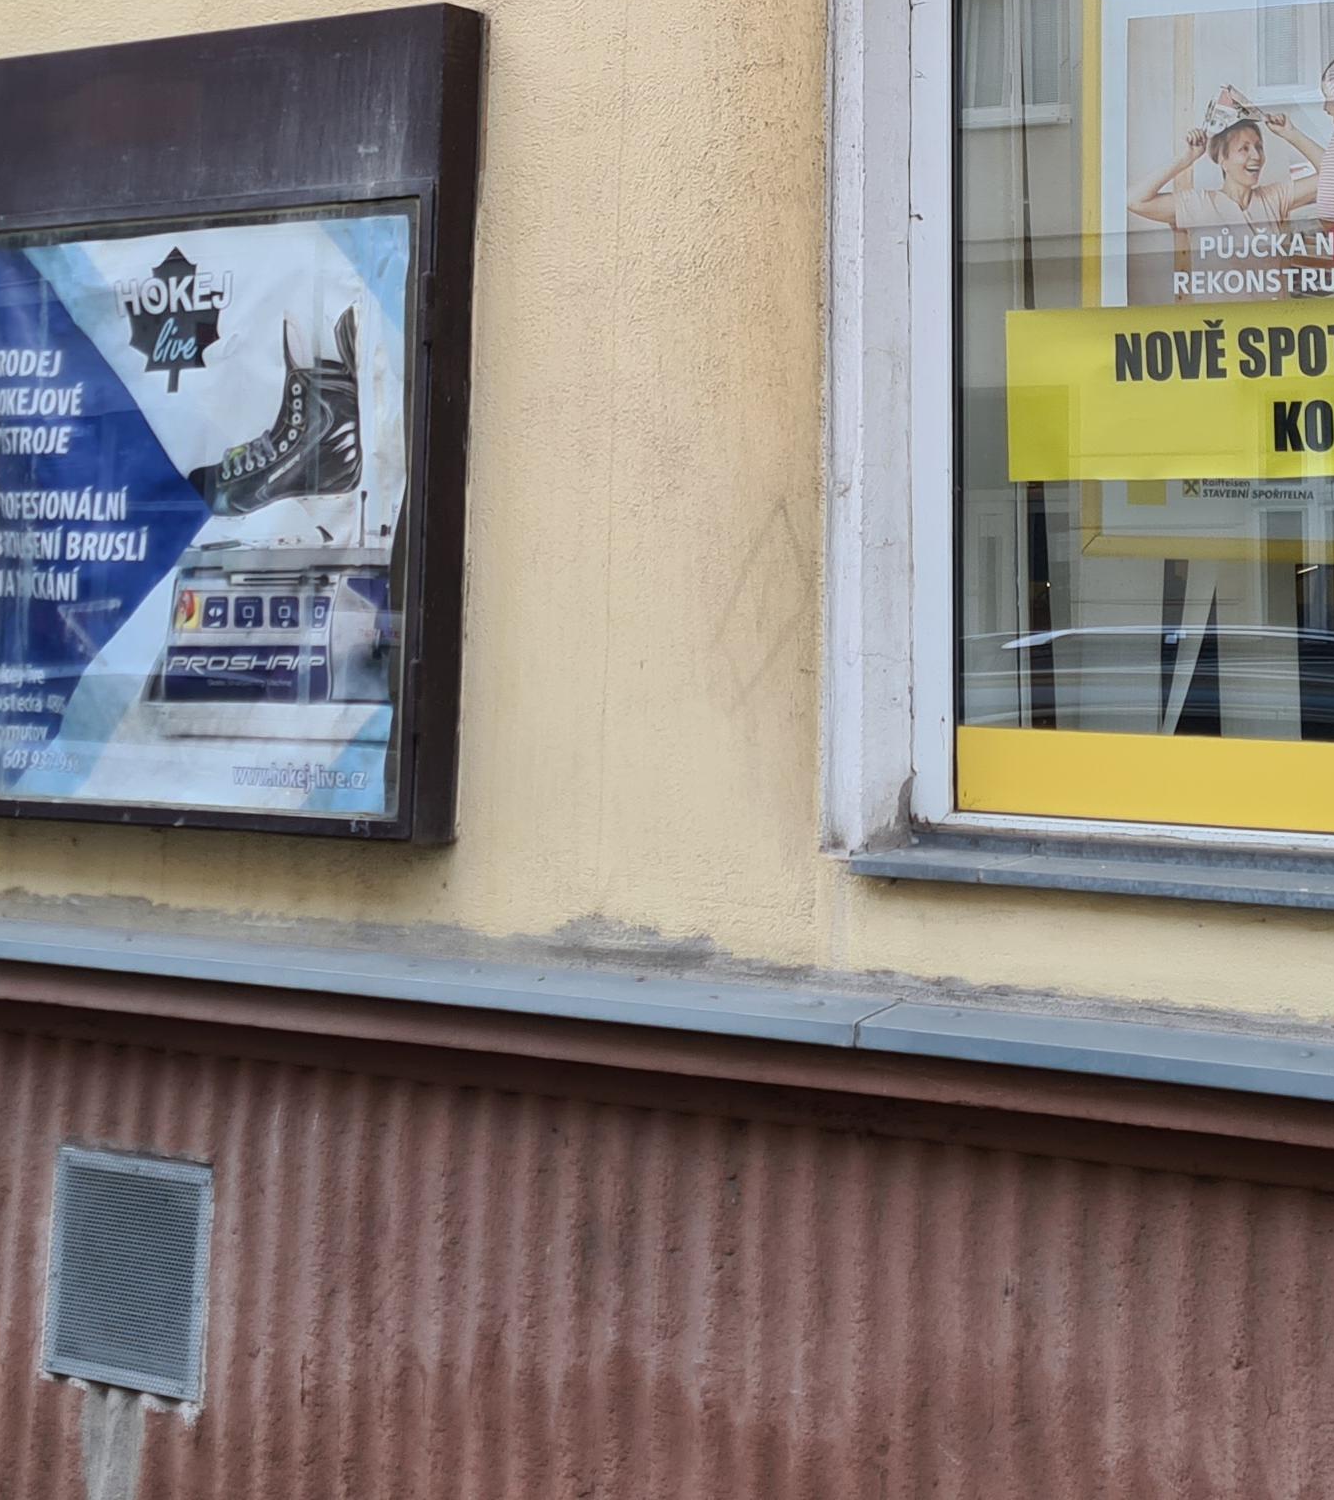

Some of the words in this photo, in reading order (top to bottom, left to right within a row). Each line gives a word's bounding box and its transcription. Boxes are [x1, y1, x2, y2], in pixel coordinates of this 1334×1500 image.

[1200, 227, 1306, 260] PŮJČKA
[114, 271, 234, 317] HOKEJ
[153, 317, 198, 362] live
[1115, 319, 1227, 382] NOVĚ
[1202, 487, 1249, 499] STAVEBNÍ
[1252, 487, 1314, 500] SPOŘITELNA
[65, 525, 149, 561] BRUSLÍ
